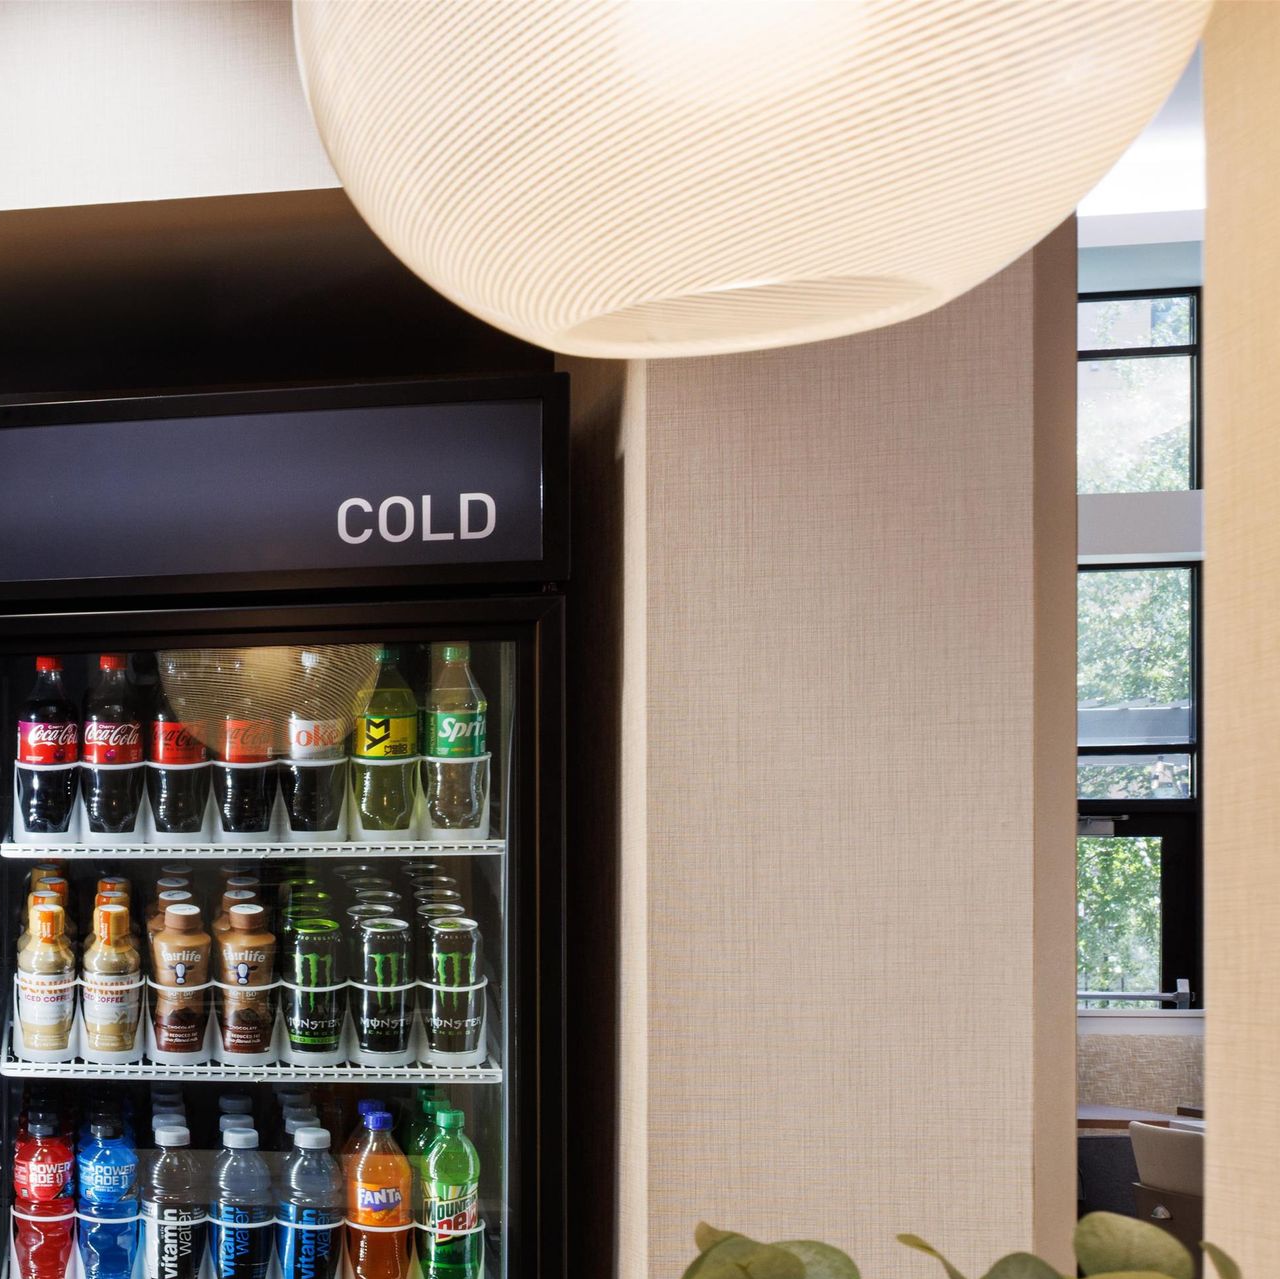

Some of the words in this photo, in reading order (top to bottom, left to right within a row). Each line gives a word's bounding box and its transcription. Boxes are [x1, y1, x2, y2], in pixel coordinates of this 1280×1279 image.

[336, 492, 497, 545] COLD
[161, 950, 202, 962] fairlife
[223, 950, 266, 962] fairlife
[25, 994, 41, 1002] ICED
[425, 1017, 481, 1029] MONSTER
[29, 1162, 71, 1174] POWER
[95, 1164, 136, 1175] POWER
[30, 1174, 54, 1184] ADE
[95, 1174, 119, 1186] ADE
[358, 1188, 402, 1205] FANTA
[179, 1209, 192, 1257] water
[235, 1207, 250, 1255] water
[317, 1211, 332, 1258] water
[160, 1206, 178, 1279] vitamin
[221, 1205, 236, 1279] vitamin
[301, 1208, 317, 1279] vitamin
